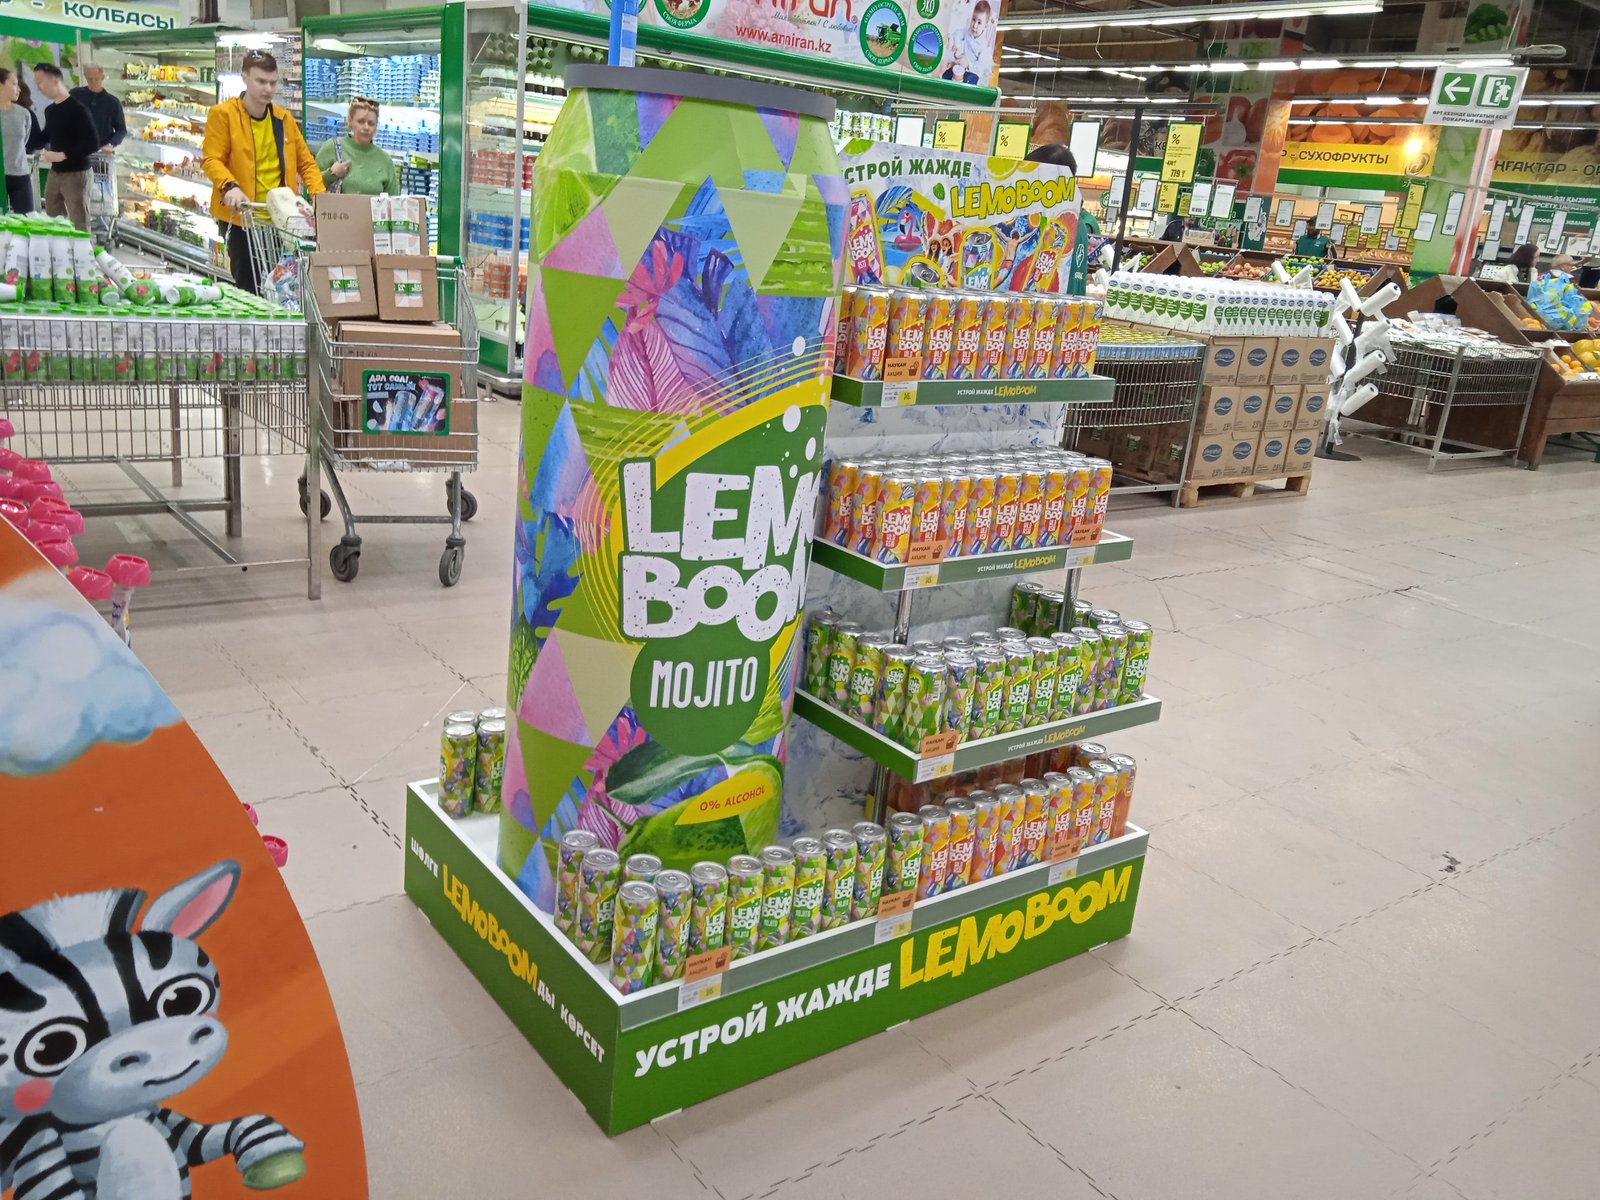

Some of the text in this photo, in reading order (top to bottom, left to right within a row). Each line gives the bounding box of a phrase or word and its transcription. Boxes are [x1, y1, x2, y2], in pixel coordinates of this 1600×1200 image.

[64, 2, 174, 30] КОЛБАСЫ
[735, 25, 832, 53] www.amiran.kz
[843, 156, 972, 185] СТРОЙ ЖАЖДЕ
[1298, 150, 1390, 165] СУХОФРУКТЫ
[950, 176, 1076, 220] LEMOBOOM
[367, 382, 383, 391] ТОТ
[994, 385, 1037, 398] LEMOBOOM
[977, 564, 996, 573] УСТРОЙ
[1014, 555, 1057, 570] LEMOBOOM
[649, 656, 758, 708] MOJITO
[1007, 741, 1026, 752] УСТРОЙ
[1044, 725, 1087, 745] LEMOBOOM
[700, 785, 765, 812] 0% ALCOHOL
[410, 837, 439, 878] ШӨЛГЕ
[442, 864, 538, 992] LEMOBOOM
[560, 1003, 604, 1063] КӨРСЕТ
[634, 865, 1132, 1078] УСТРОЙ ЖАЖДЕ LEMOBOOM
